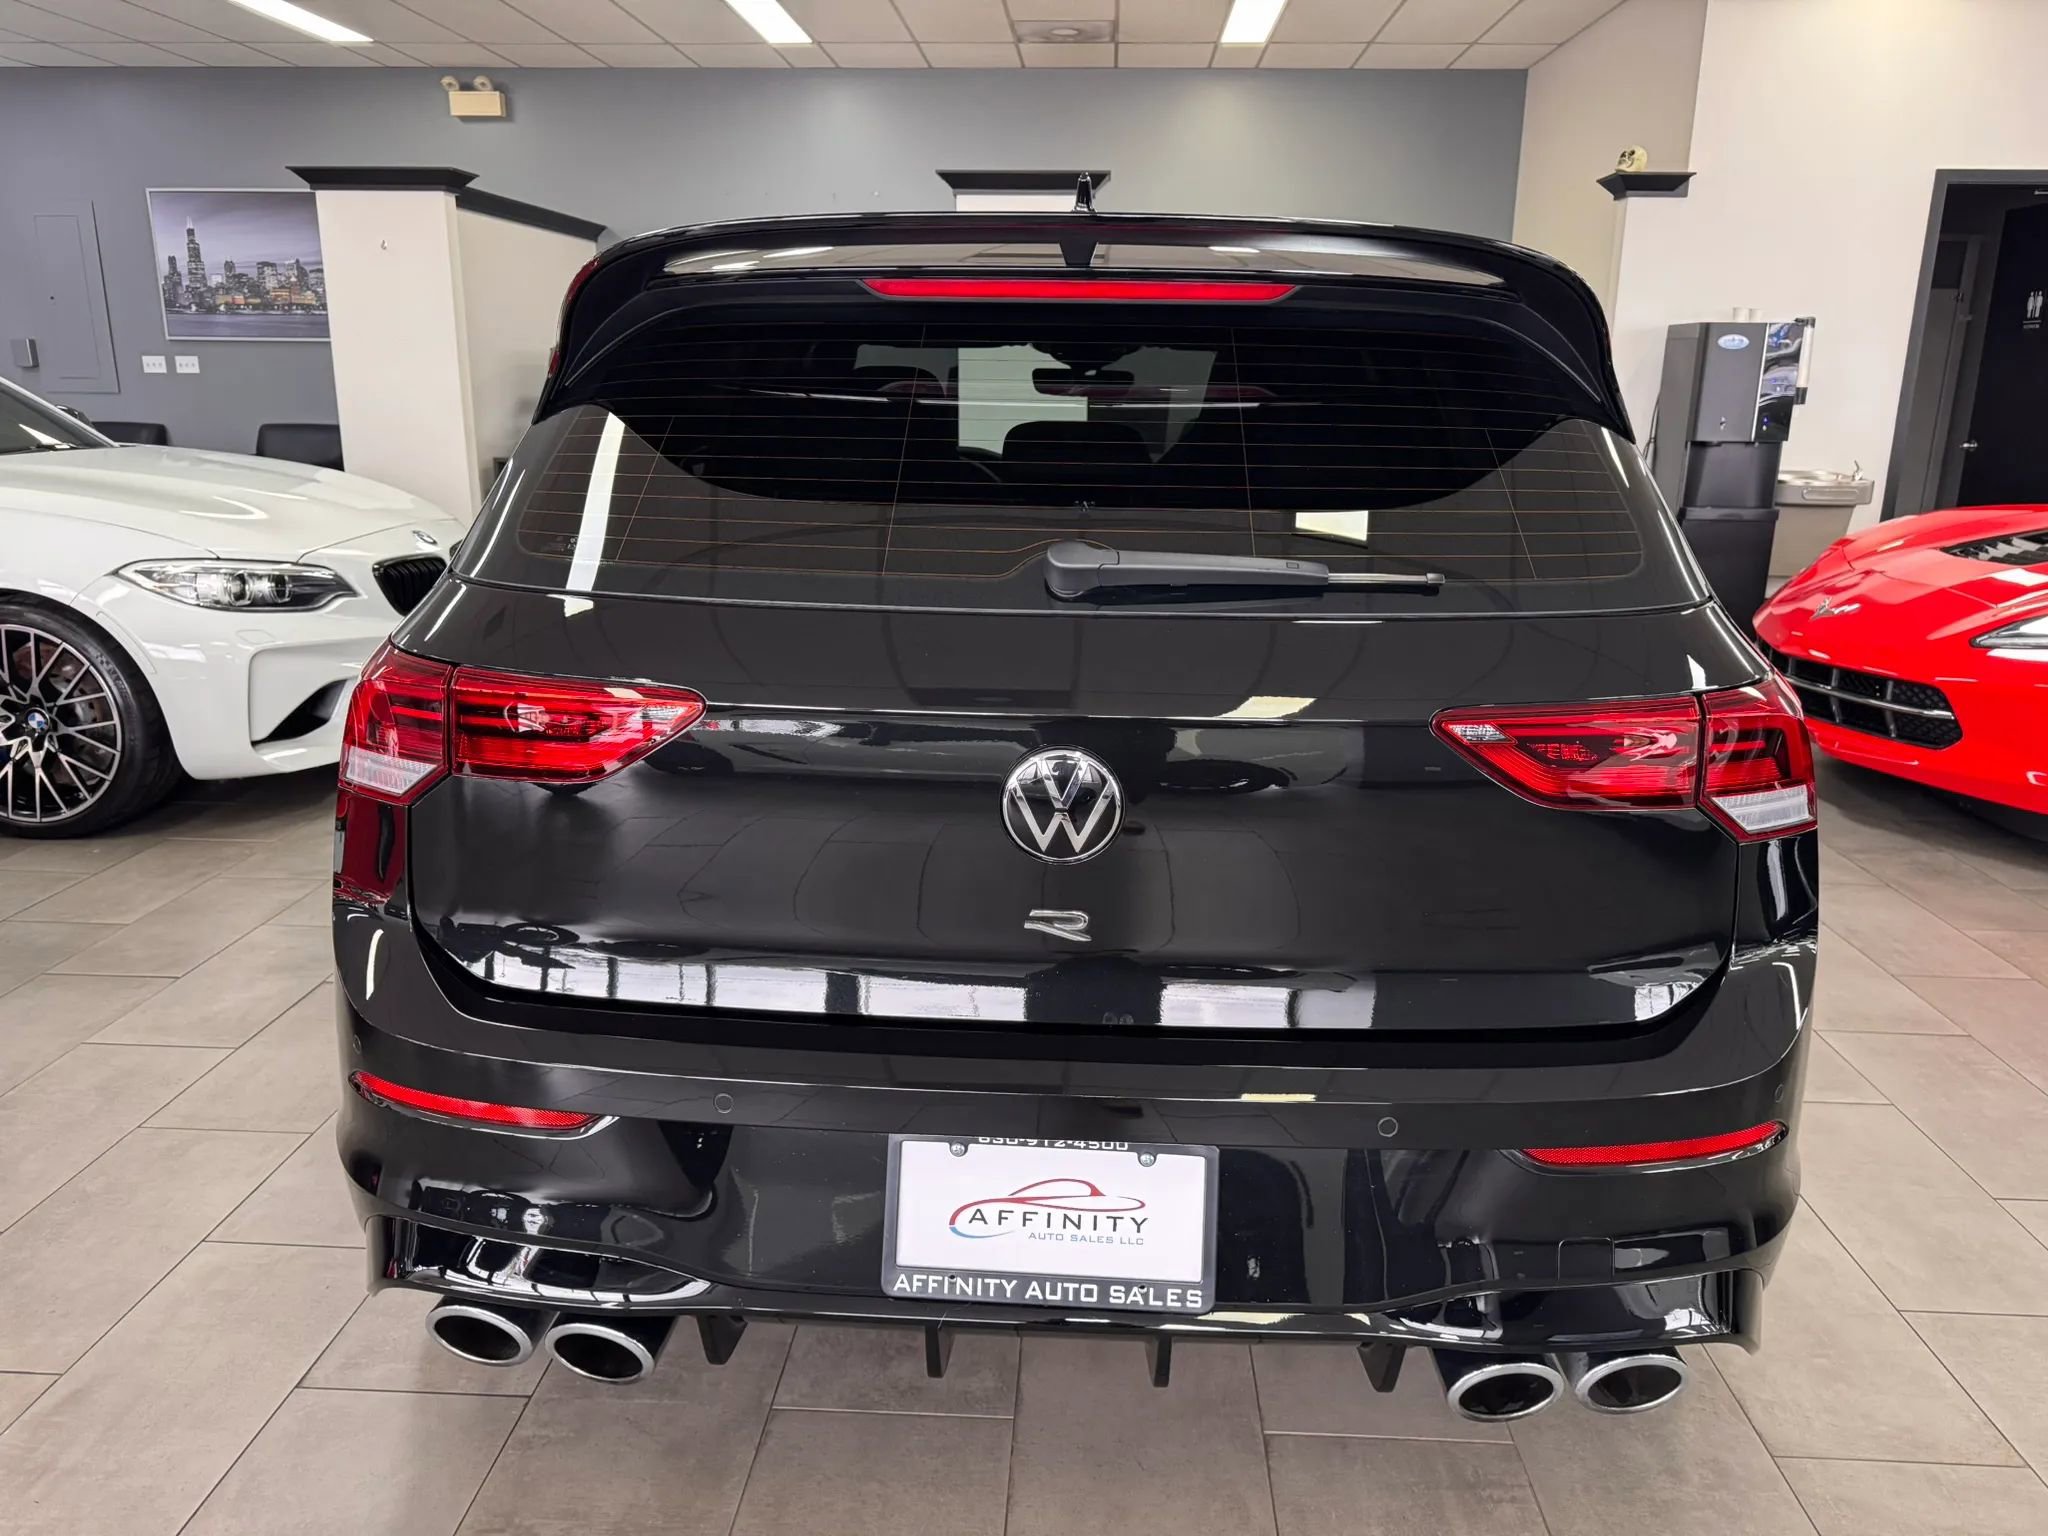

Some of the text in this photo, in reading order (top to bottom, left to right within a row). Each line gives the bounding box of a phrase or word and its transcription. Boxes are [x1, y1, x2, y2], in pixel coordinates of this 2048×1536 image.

[1023, 908, 1092, 942] R
[968, 1207, 1149, 1234] AFFINITY
[1028, 1231, 1144, 1246] AUTO SALES LLC
[893, 1273, 1203, 1309] AFFINITY AUTO SALES
